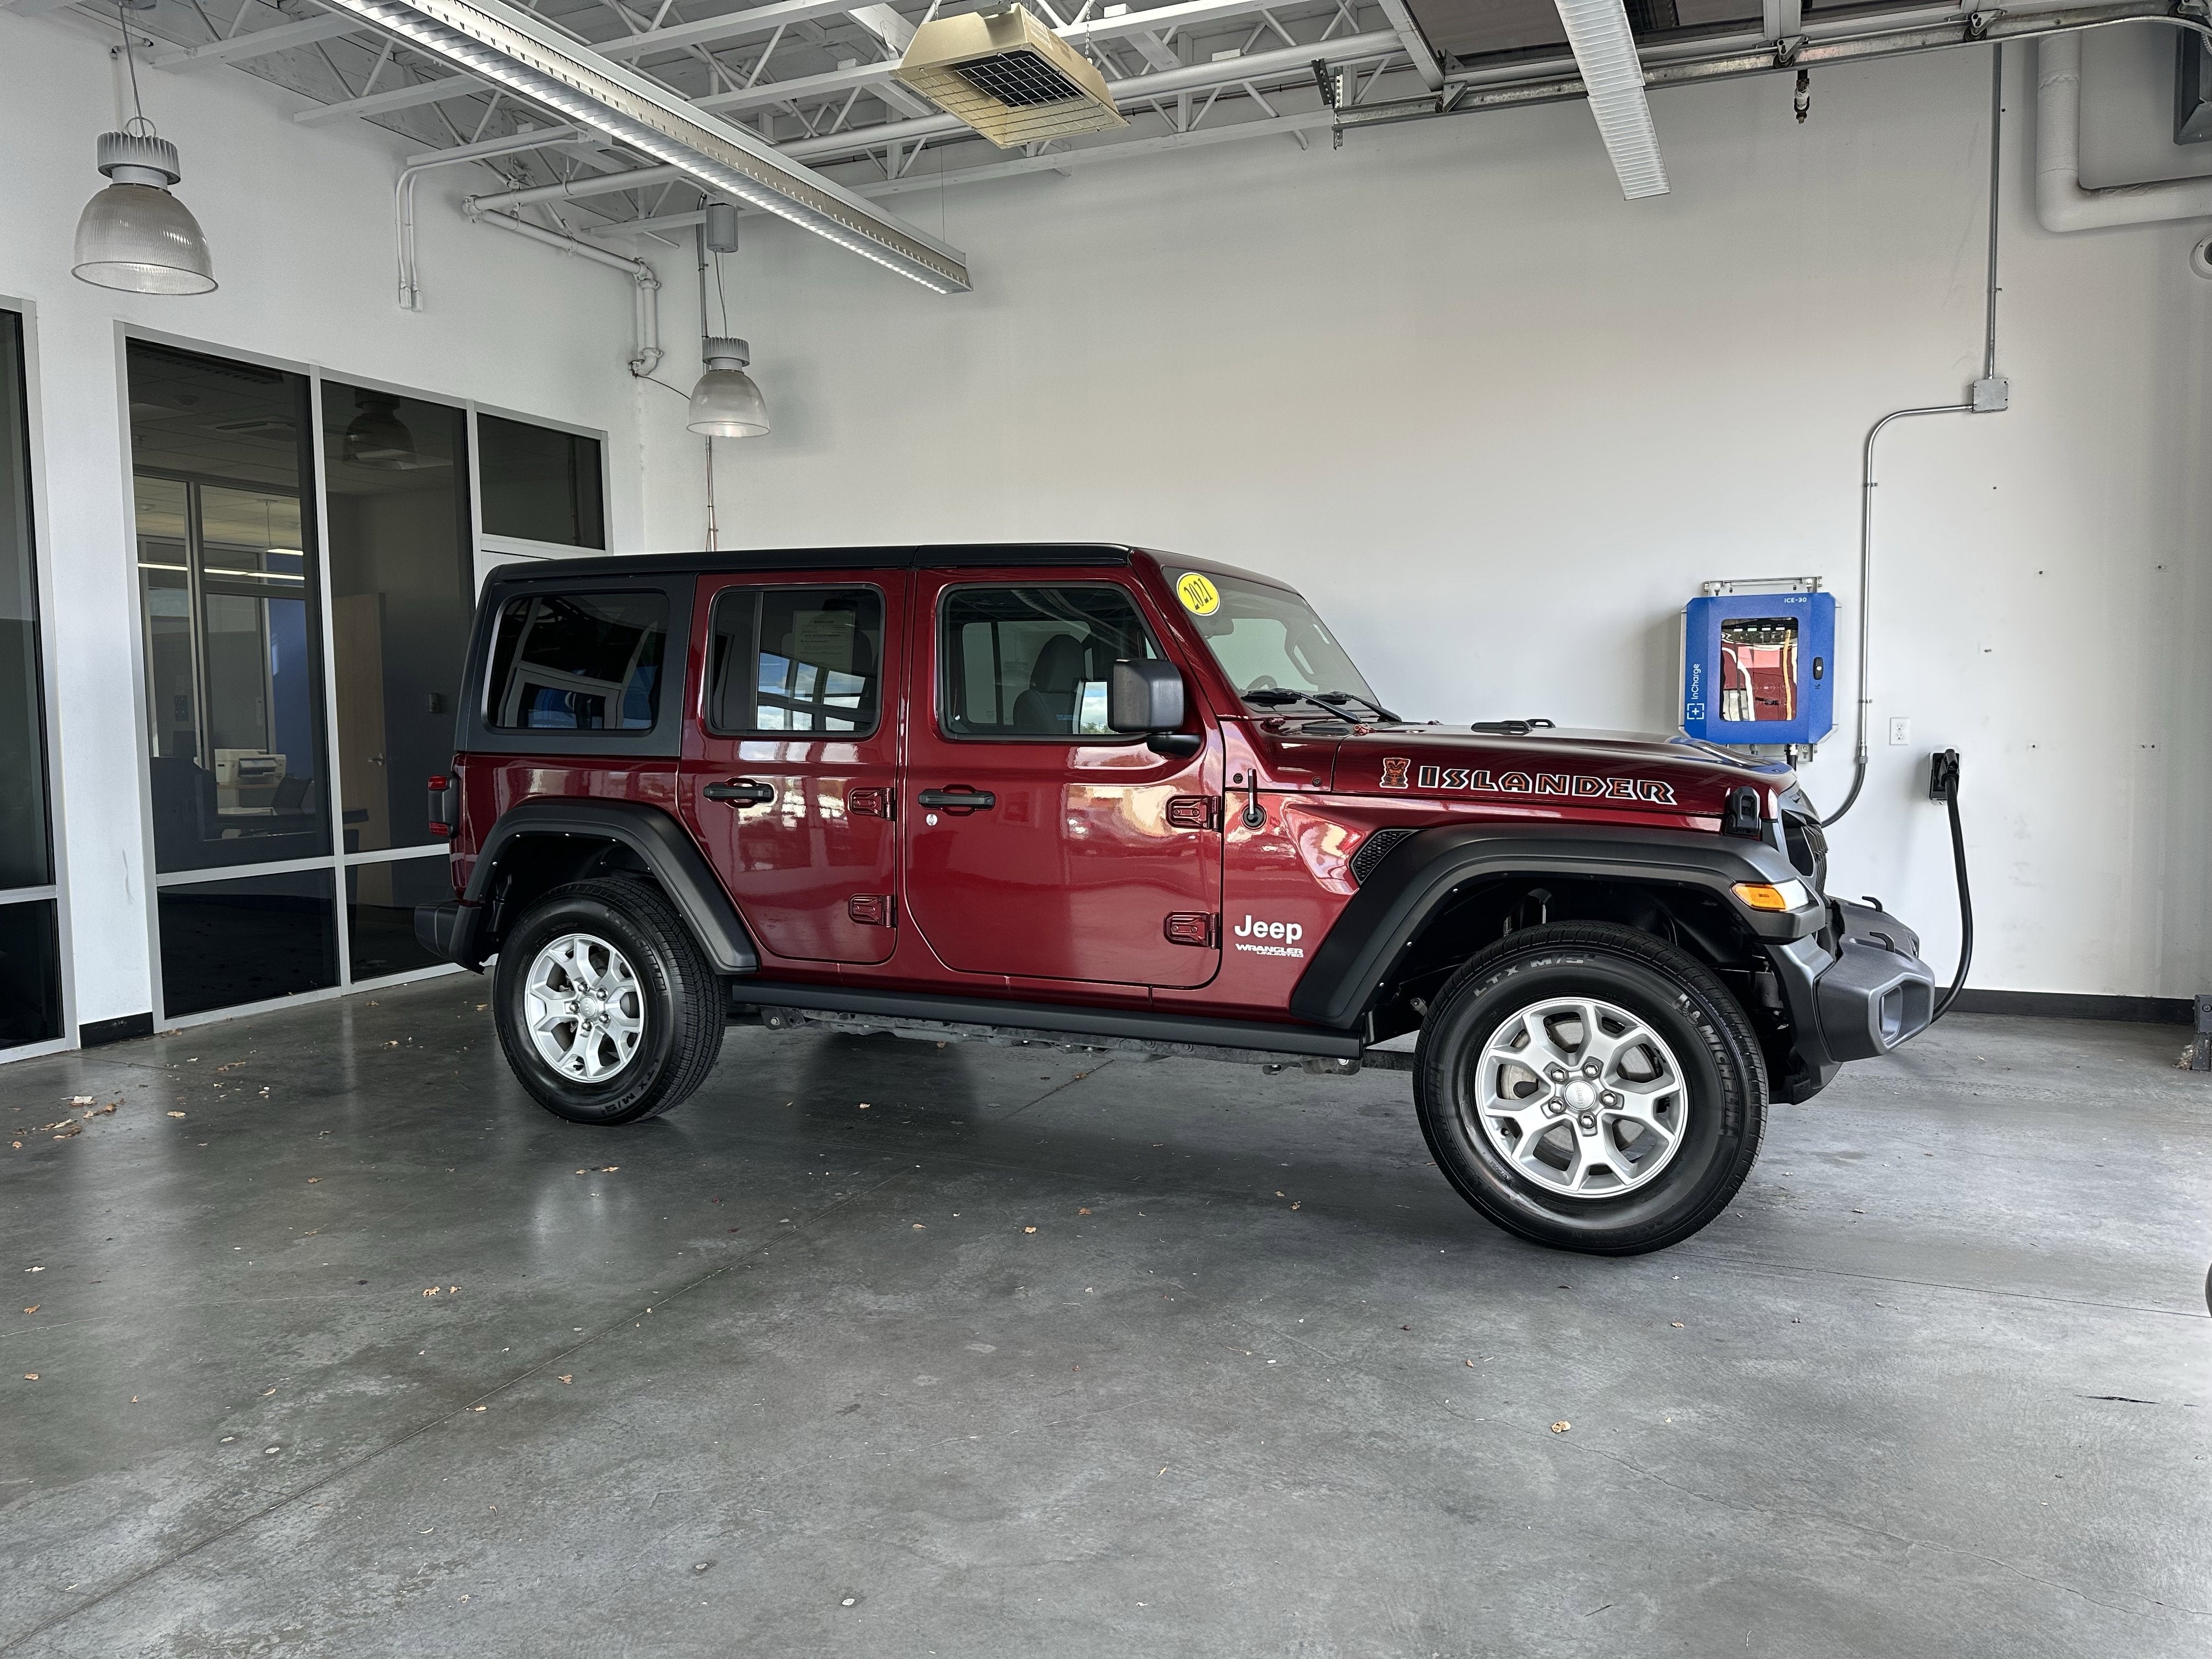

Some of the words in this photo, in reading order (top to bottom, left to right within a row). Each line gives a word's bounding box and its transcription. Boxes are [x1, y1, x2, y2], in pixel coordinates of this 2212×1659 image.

[1183, 578, 1214, 611] 2021
[1691, 663, 1701, 699] InCharge
[1418, 765, 1678, 806] ISLANDER
[1234, 915, 1303, 944] Jeep
[1235, 944, 1304, 954] WRANGLER
[1473, 965, 1520, 997] LTX
[1699, 1024, 1739, 1129] MICHELIN
